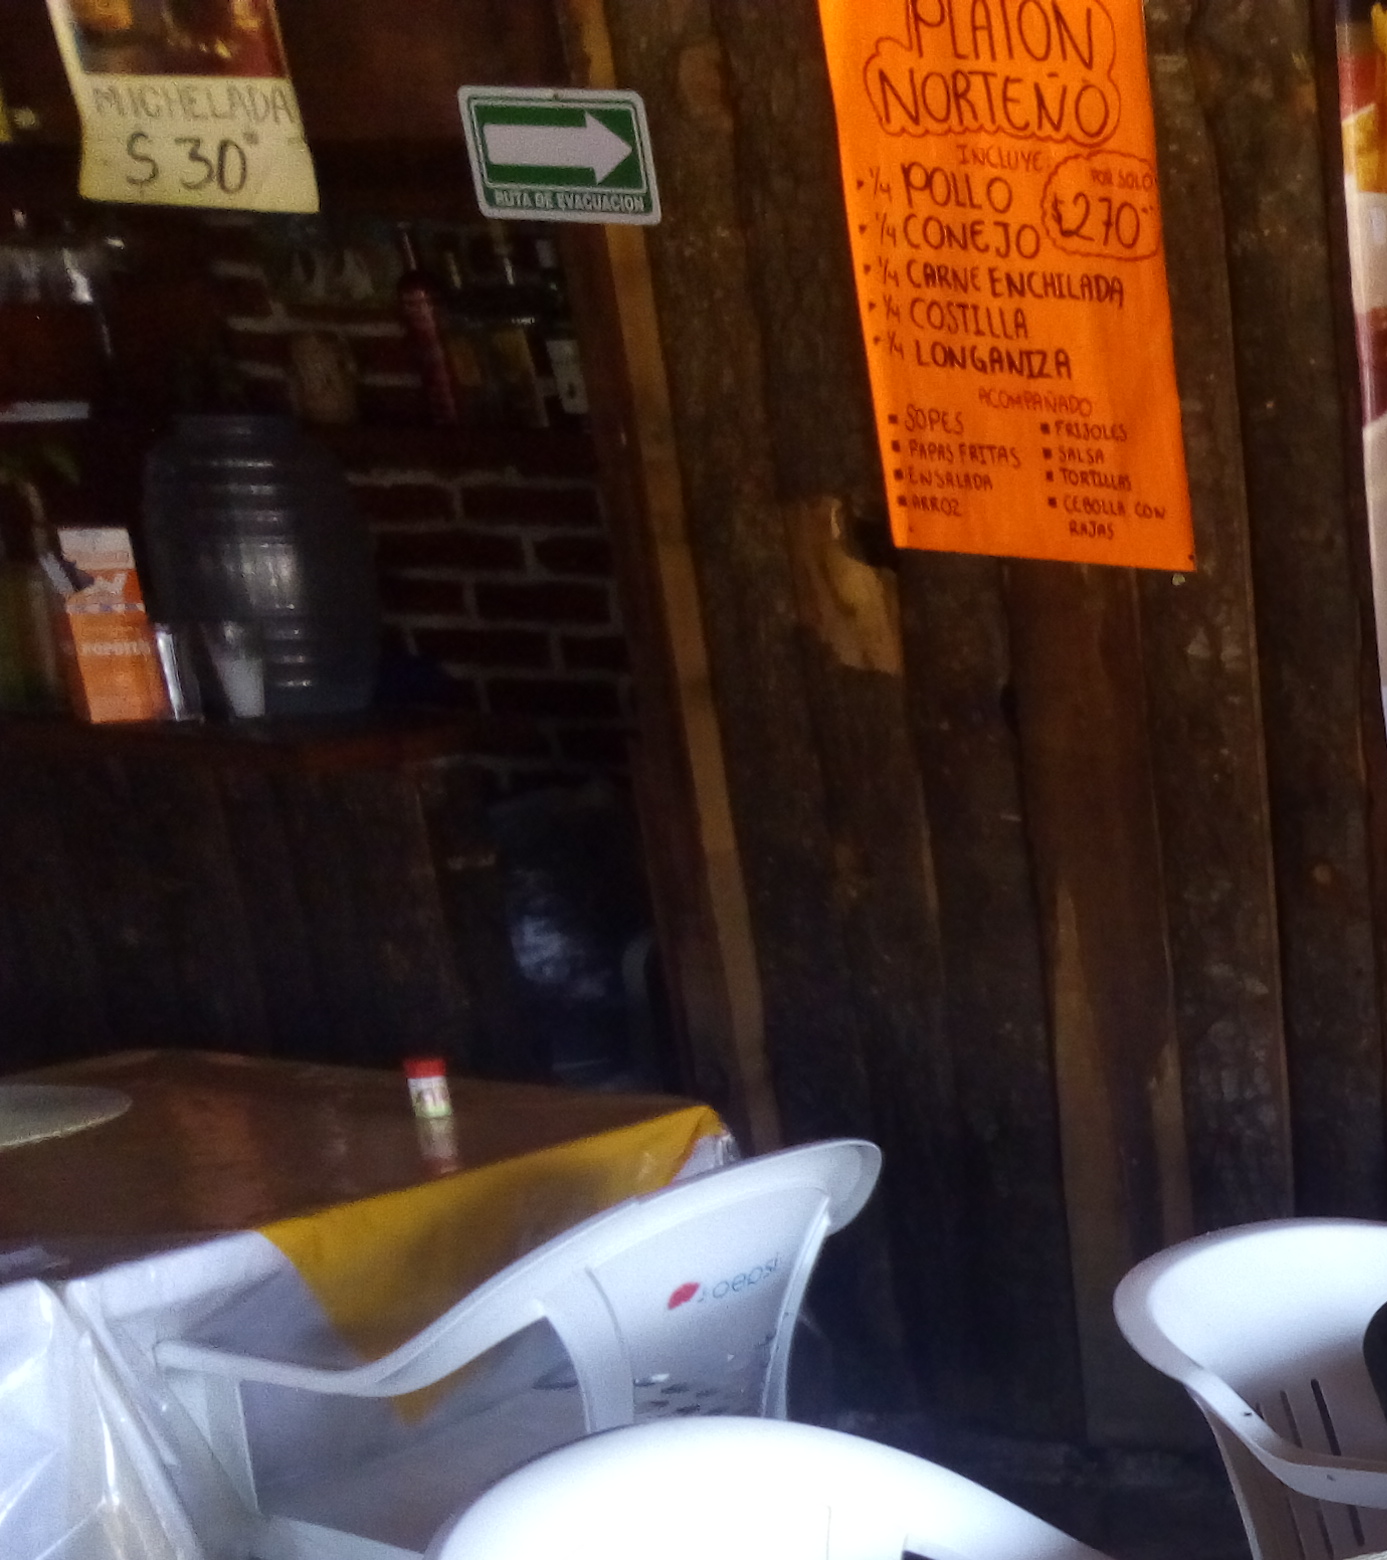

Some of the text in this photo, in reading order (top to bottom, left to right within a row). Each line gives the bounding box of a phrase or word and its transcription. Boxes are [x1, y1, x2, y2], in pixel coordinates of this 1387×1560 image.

[93, 83, 297, 125] MICHELADA
[878, 67, 1109, 138] NORTEÑO
[956, 144, 1043, 172] INCLUYE
[495, 189, 531, 207] RUTA
[535, 191, 553, 209] DE
[901, 161, 1013, 214] POLLO
[903, 213, 1040, 259] CONEJO
[906, 259, 981, 294] CARNE
[988, 266, 1124, 310] ENCHILADA
[910, 297, 1028, 340] COSTILLA
[915, 339, 1072, 381] LONGANIZA
[905, 404, 964, 435] SOPES
[1054, 420, 1128, 442] FRIJOLES
[909, 440, 1022, 469] PAPAS FRITAS
[1058, 446, 1105, 465] SALSA
[909, 467, 993, 491] ENSALADA
[912, 495, 963, 518] ARROZ
[1063, 496, 1166, 520] CEBOLLA CON
[1069, 519, 1115, 541] RAJAS
